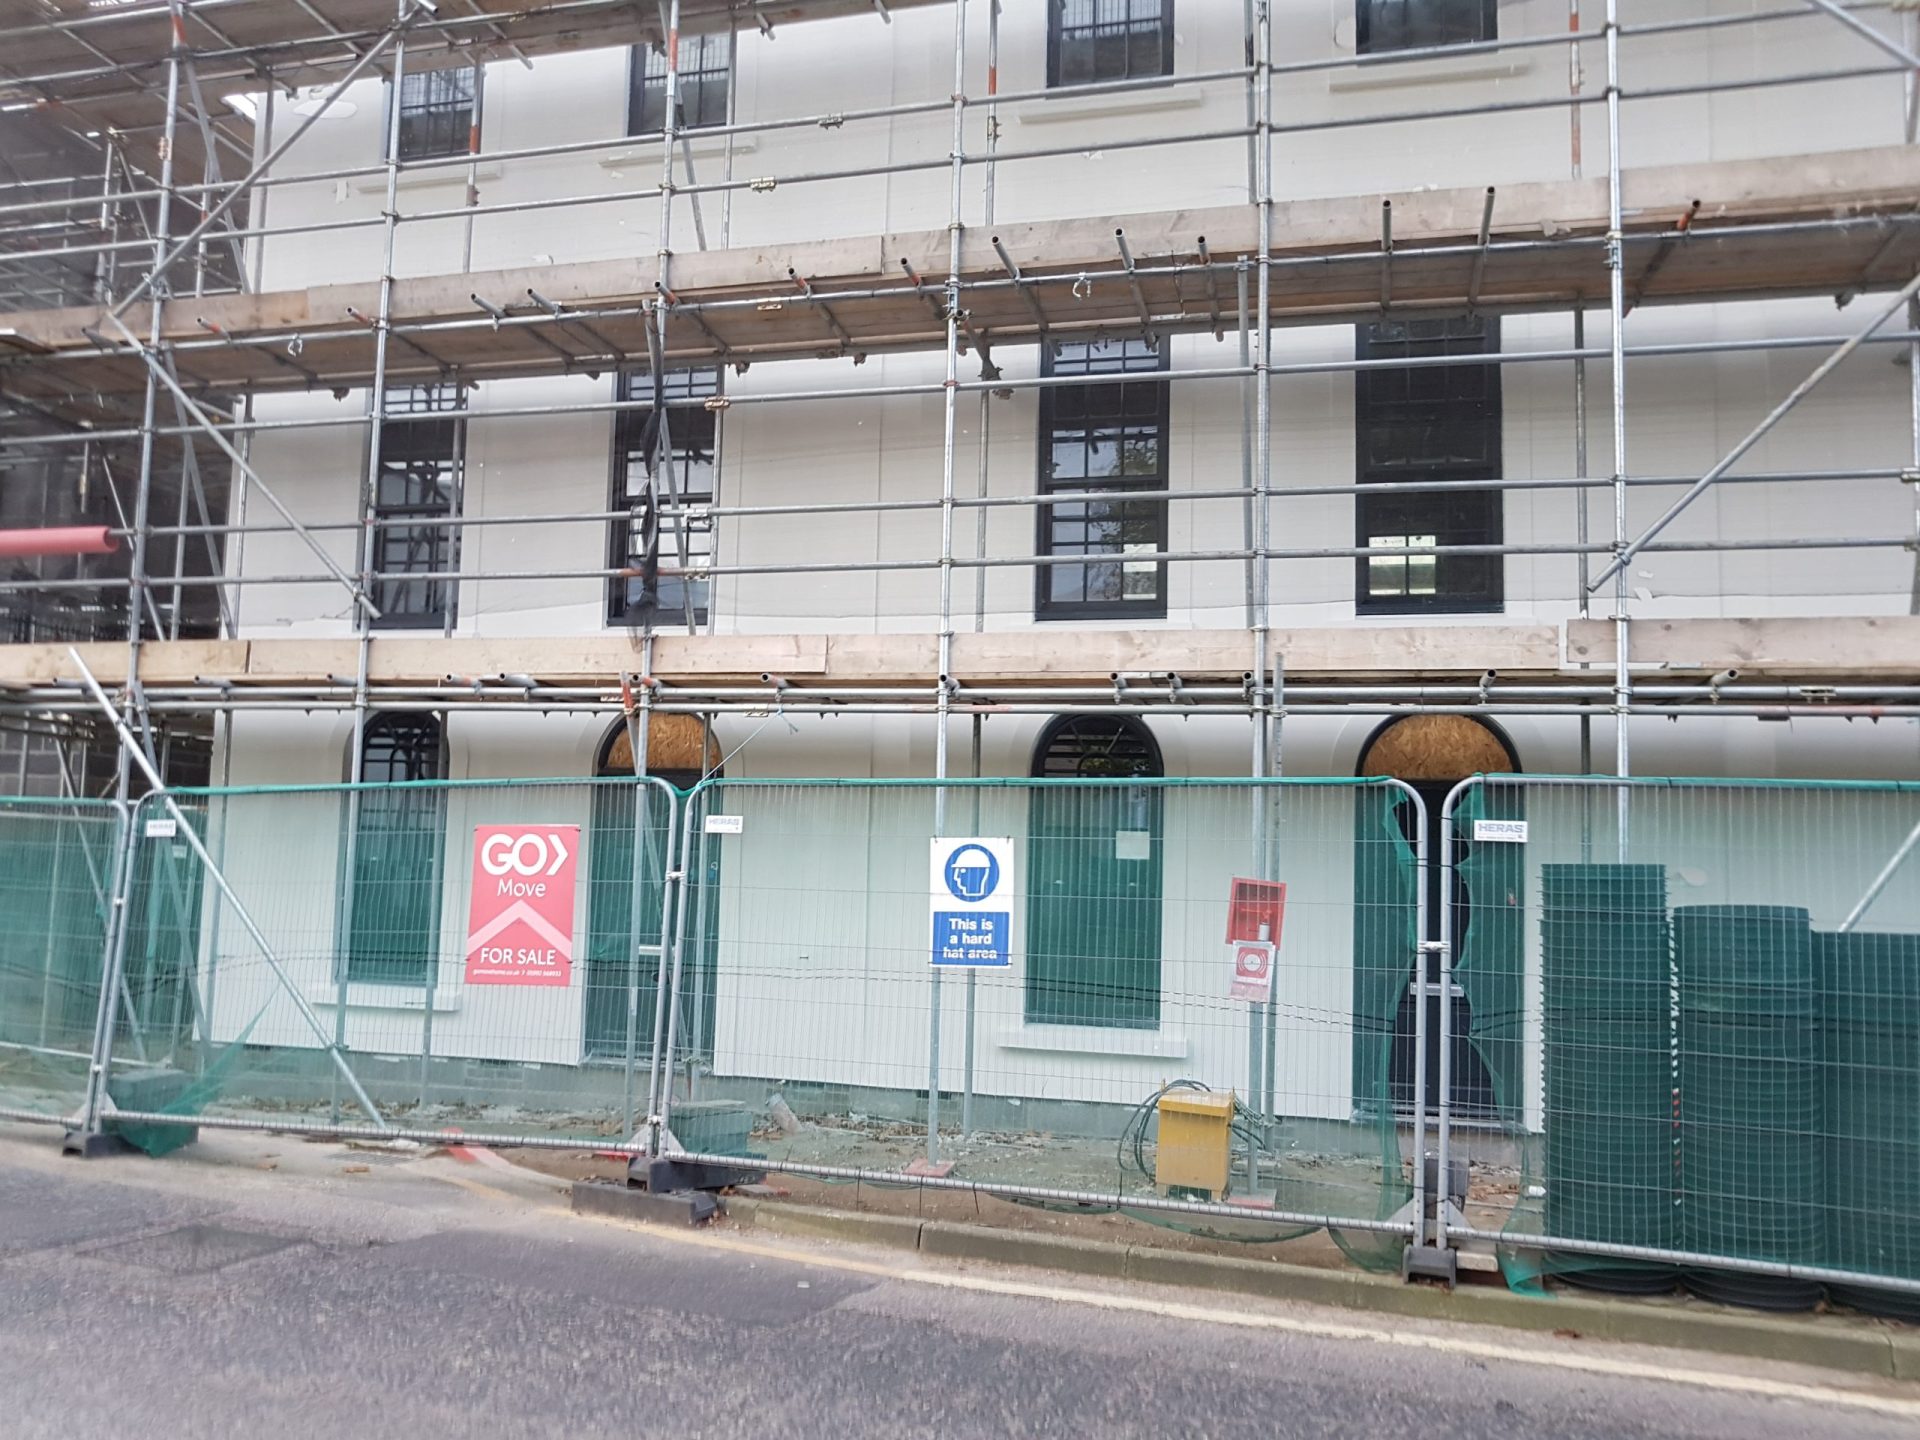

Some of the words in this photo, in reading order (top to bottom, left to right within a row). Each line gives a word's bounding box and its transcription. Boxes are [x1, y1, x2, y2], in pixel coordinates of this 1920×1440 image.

[1478, 823, 1524, 833] HERAS
[497, 878, 546, 897] Move
[949, 918, 977, 930] This
[981, 918, 994, 930] is
[949, 934, 958, 945] a
[962, 933, 992, 945] hard
[480, 947, 513, 964] FOR
[517, 948, 556, 966] SALE
[943, 947, 964, 959] hat
[967, 949, 997, 960] area
